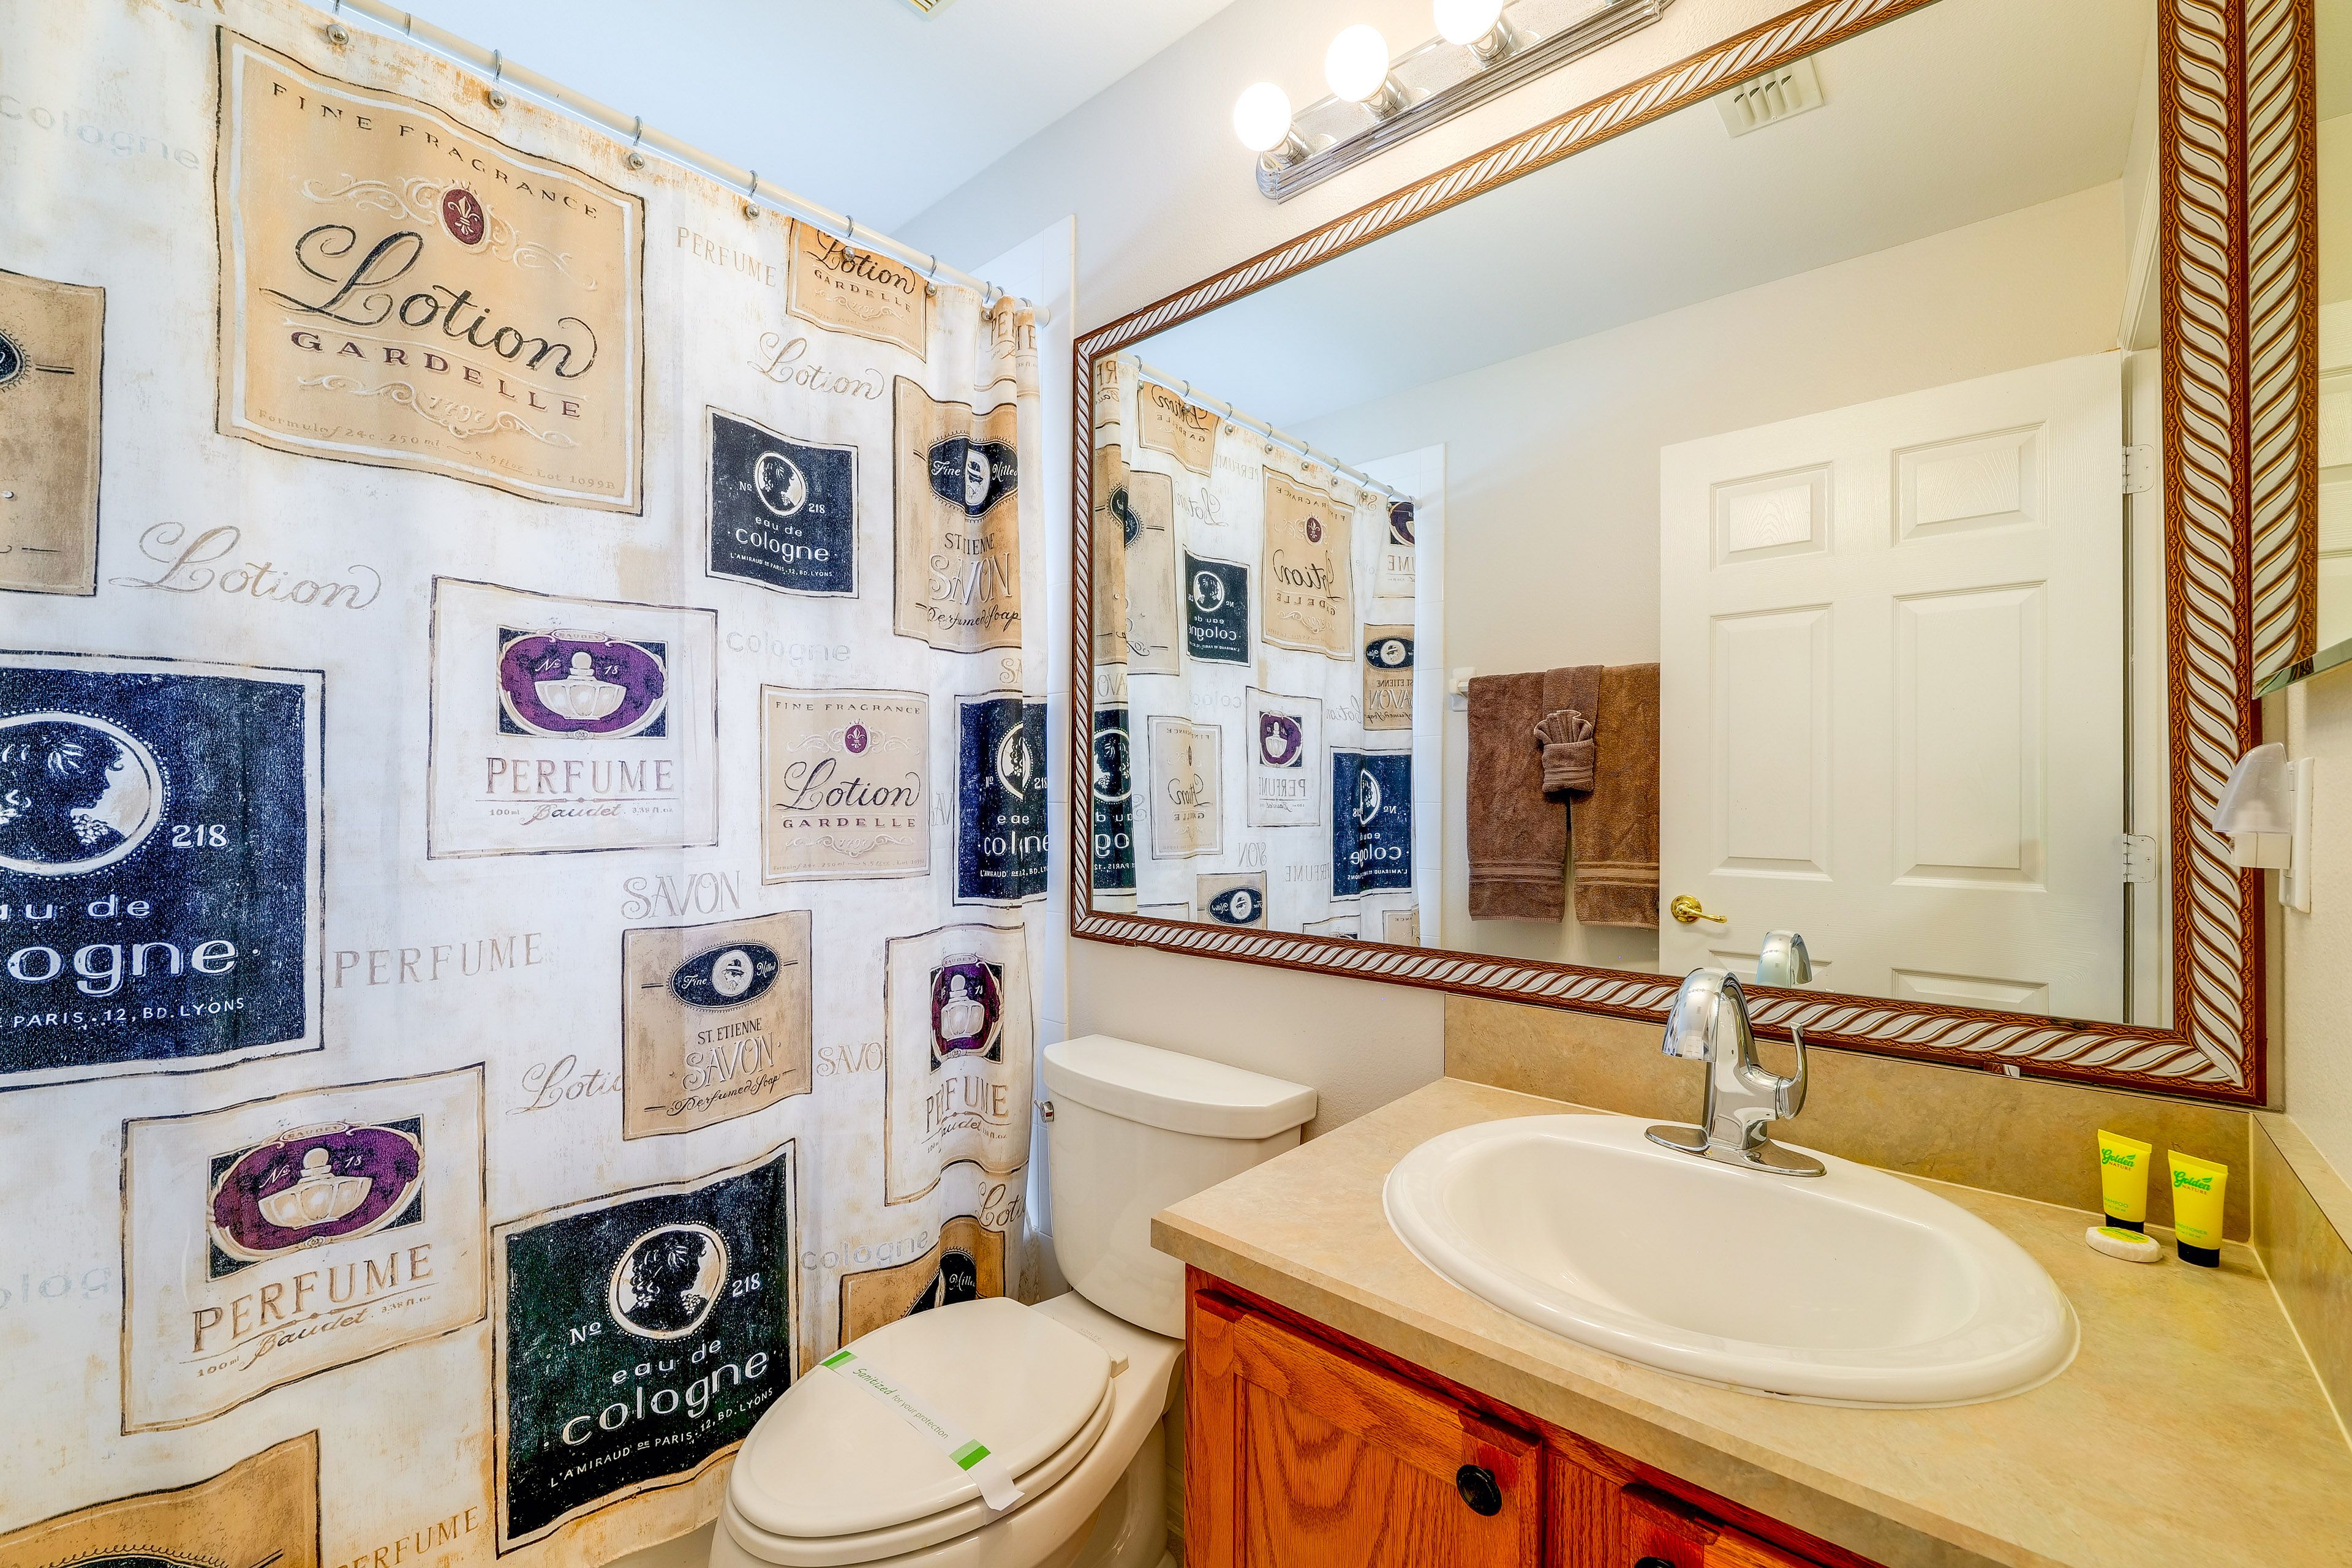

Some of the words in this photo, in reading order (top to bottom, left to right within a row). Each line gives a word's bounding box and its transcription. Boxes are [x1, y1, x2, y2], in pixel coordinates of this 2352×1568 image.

[272, 82, 372, 130] FINE
[399, 125, 597, 219] FRAGRANCE
[677, 225, 777, 288] PERFUME
[258, 224, 598, 379] Lotion
[814, 270, 911, 313] GARDELLE
[290, 331, 581, 418] GARDELLE
[747, 331, 884, 401] Lotion
[931, 461, 960, 476] Fine
[807, 502, 826, 514] 218
[755, 516, 780, 532] eau
[785, 519, 803, 537] de
[735, 528, 830, 564] cologne
[108, 521, 381, 609] Lotion
[810, 570, 833, 578] LYONS
[726, 631, 851, 666] cologne
[775, 701, 815, 712] FINE
[825, 703, 921, 715] FRAGRANCE
[485, 757, 675, 794] PERFUME
[773, 758, 921, 811] Lotion
[519, 802, 622, 826] Baudet
[782, 818, 916, 829] GARDELLE
[172, 824, 228, 849] 218
[88, 894, 151, 919] de
[620, 870, 741, 920] SAVON
[333, 932, 543, 989] PERFUME
[681, 974, 707, 990] Fine
[180, 997, 246, 1017] LYONS
[717, 1017, 763, 1041] ETIENNE
[683, 1032, 775, 1091] SAVON
[750, 1072, 781, 1095] Soap
[2101, 1148, 2135, 1168] Golden
[2109, 1161, 2132, 1171] NATURE
[2174, 1170, 2211, 1191] Golden
[2182, 1184, 2208, 1196] NATURE
[801, 1231, 929, 1270] cologne
[192, 1243, 435, 1353] PERFUME
[732, 1272, 762, 1298] 218
[239, 1308, 369, 1371] Baudet
[612, 1358, 675, 1385] eau
[692, 1339, 722, 1365] de
[562, 1351, 769, 1447] cologne
[853, 1367, 898, 1396] Sanitized
[914, 1410, 949, 1440] protection
[551, 1446, 631, 1488] L'AMIRAUD
[741, 1387, 774, 1412] LYONS
